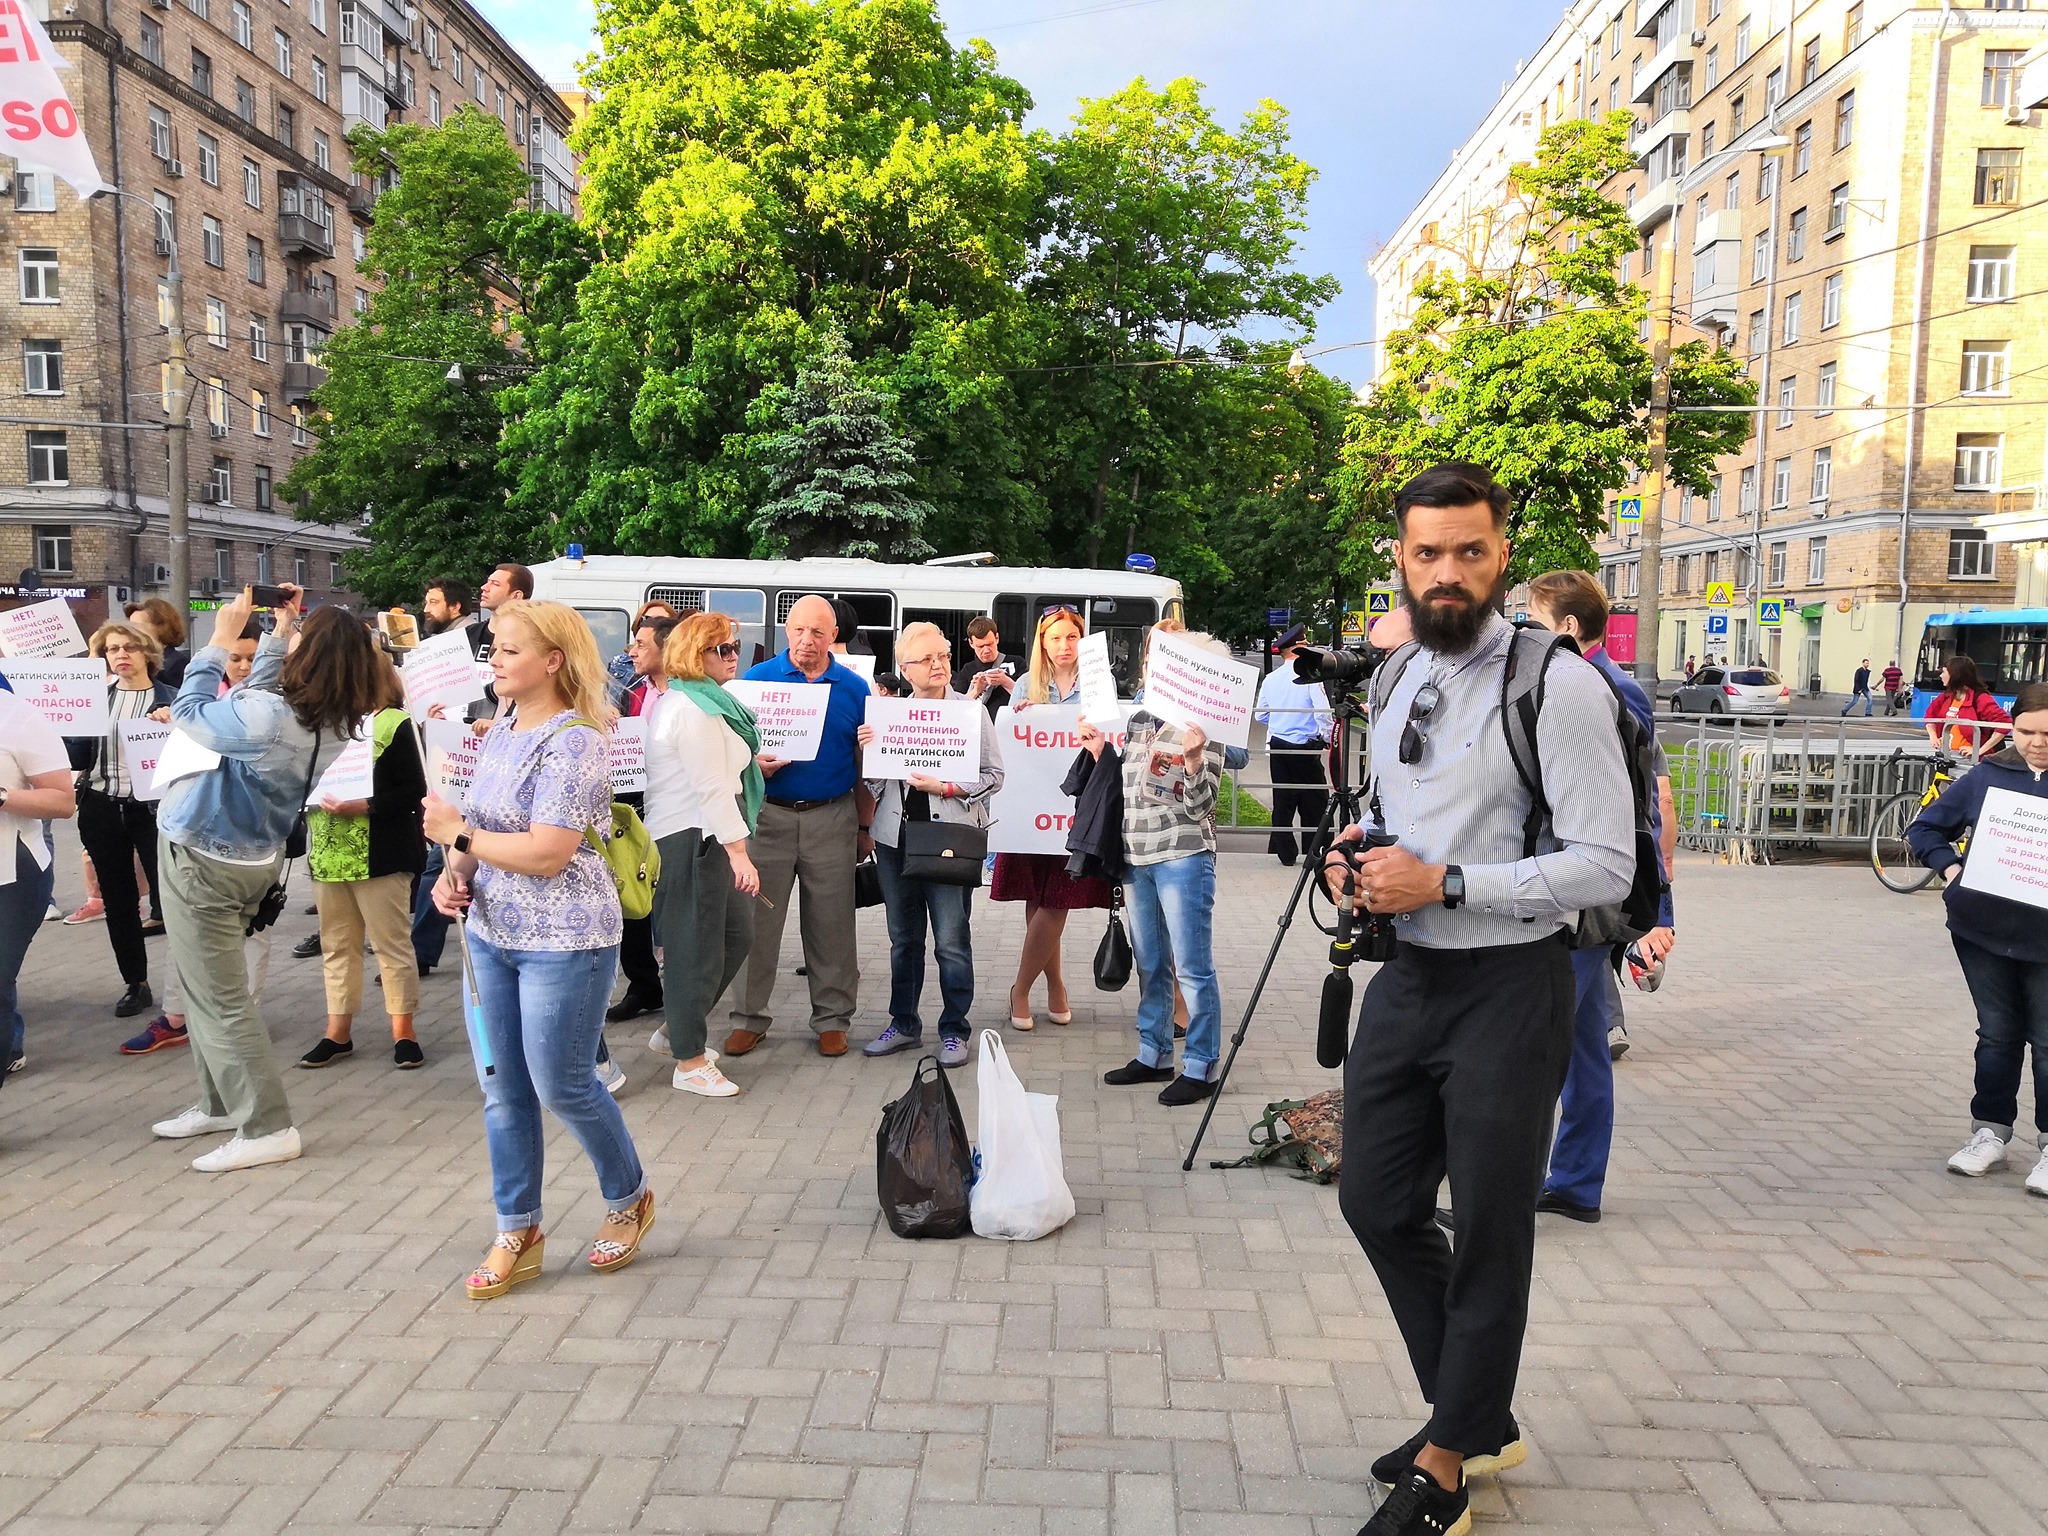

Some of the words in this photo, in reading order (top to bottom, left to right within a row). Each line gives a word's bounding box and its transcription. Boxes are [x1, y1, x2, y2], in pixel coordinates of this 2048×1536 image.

[12, 610, 35, 622] НЕТ!
[2, 614, 60, 635] КОММЕРЧЕСКОЙ
[45, 623, 64, 632] ПОД
[1713, 617, 1724, 632] P
[16, 638, 41, 648] ВИДОМ
[42, 633, 57, 642] ТПУ
[19, 637, 71, 655] НАГАТИНСКОМ
[434, 644, 465, 659] ЗАТОНА
[1158, 643, 1189, 665] Москве
[1190, 660, 1220, 677] нужен
[1222, 672, 1245, 687] мэр,
[1166, 663, 1207, 688] любящий
[1209, 683, 1221, 693] её
[43, 684, 59, 694] ЗА
[1151, 670, 1198, 699] уважающий
[1200, 694, 1231, 711] права
[1234, 704, 1247, 714] на
[761, 691, 792, 703] НЕТ!
[1152, 684, 1176, 702] жизнь
[1177, 698, 1240, 725] москвичей!!!
[773, 707, 817, 717] ДЕРЕВЬЕВ
[909, 709, 941, 721] НЕТ!
[775, 718, 793, 726] ТПУ
[888, 724, 960, 735] УПЛОТНЕНИЮ
[882, 736, 905, 745] ПОД
[907, 737, 945, 747] ВИДОМ
[948, 739, 967, 747] ТПУ
[627, 747, 645, 756] ПОД
[881, 747, 887, 755] В
[890, 747, 965, 757] НАГАТИНСКОМ
[904, 759, 941, 768] ЗАТОНЕ
[442, 764, 460, 777] ПОД
[441, 776, 447, 784] В
[1989, 827, 2033, 845] Полный
[2005, 845, 2017, 854] за
